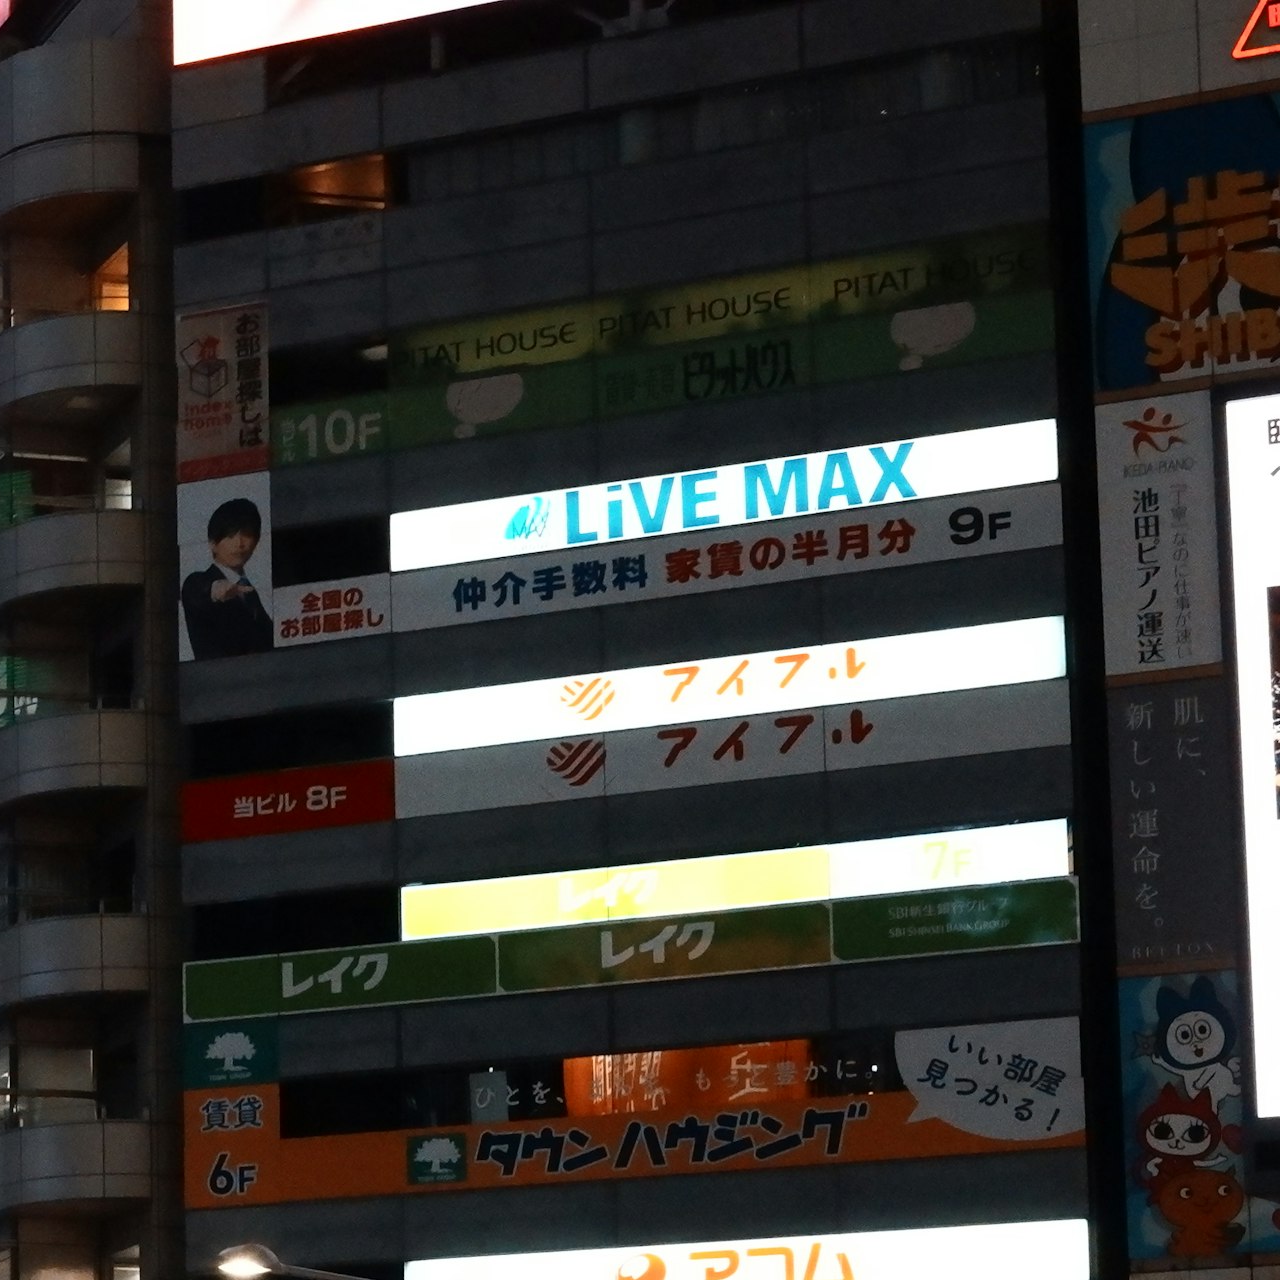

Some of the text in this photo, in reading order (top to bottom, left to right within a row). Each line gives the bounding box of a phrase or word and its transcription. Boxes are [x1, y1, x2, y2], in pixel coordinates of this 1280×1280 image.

[834, 248, 1036, 301] PITAT HOUSE
[599, 286, 792, 340] PITAT HOUSE
[391, 321, 576, 371] PITAT HOUSE
[297, 409, 382, 458] 10F
[564, 441, 920, 547] LiVE MAX
[452, 506, 1012, 612] 仲介手数料 家賃の半月分 9F
[1133, 487, 1165, 664] 池田ピアノ運送
[280, 606, 385, 639] お部屋探し
[301, 587, 364, 614] 全国の
[663, 646, 868, 704] アイフル
[657, 709, 875, 769] アイフル
[1173, 695, 1207, 776] 肌に、
[233, 785, 348, 819] 当ビル 8F
[1126, 701, 1165, 929] 新しい運命を。
[922, 840, 976, 880] 7F
[559, 870, 660, 911] レイク
[599, 921, 714, 970] レイク
[888, 926, 907, 938] SBI
[280, 952, 389, 999] レイク
[948, 1034, 1067, 1097] いい部屋
[201, 1095, 264, 1132] 賃貸
[477, 1102, 868, 1177] タウンハウジング
[208, 1152, 257, 1196] 6F
